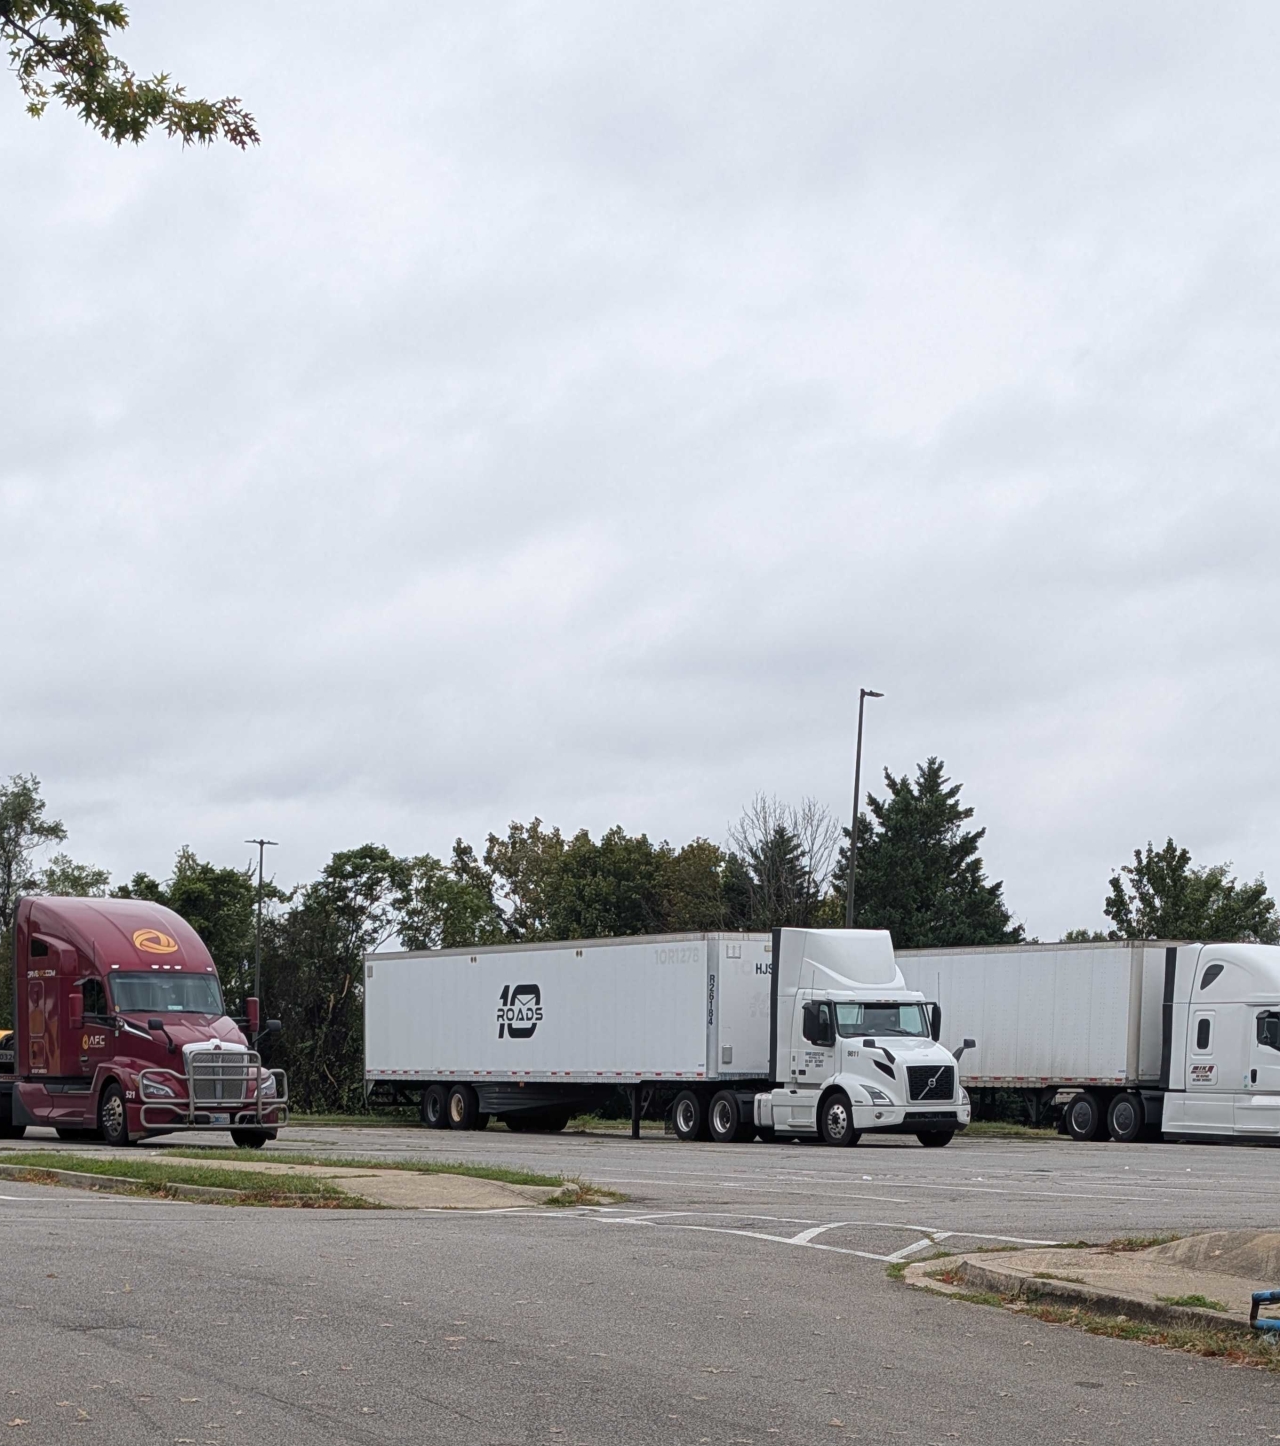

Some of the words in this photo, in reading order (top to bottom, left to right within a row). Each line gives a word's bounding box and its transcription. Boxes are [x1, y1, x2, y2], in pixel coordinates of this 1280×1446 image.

[497, 1007, 543, 1022] ROADS
[498, 984, 541, 1039] 10
[708, 974, 716, 1026] R26184
[89, 1035, 105, 1045] AFC
